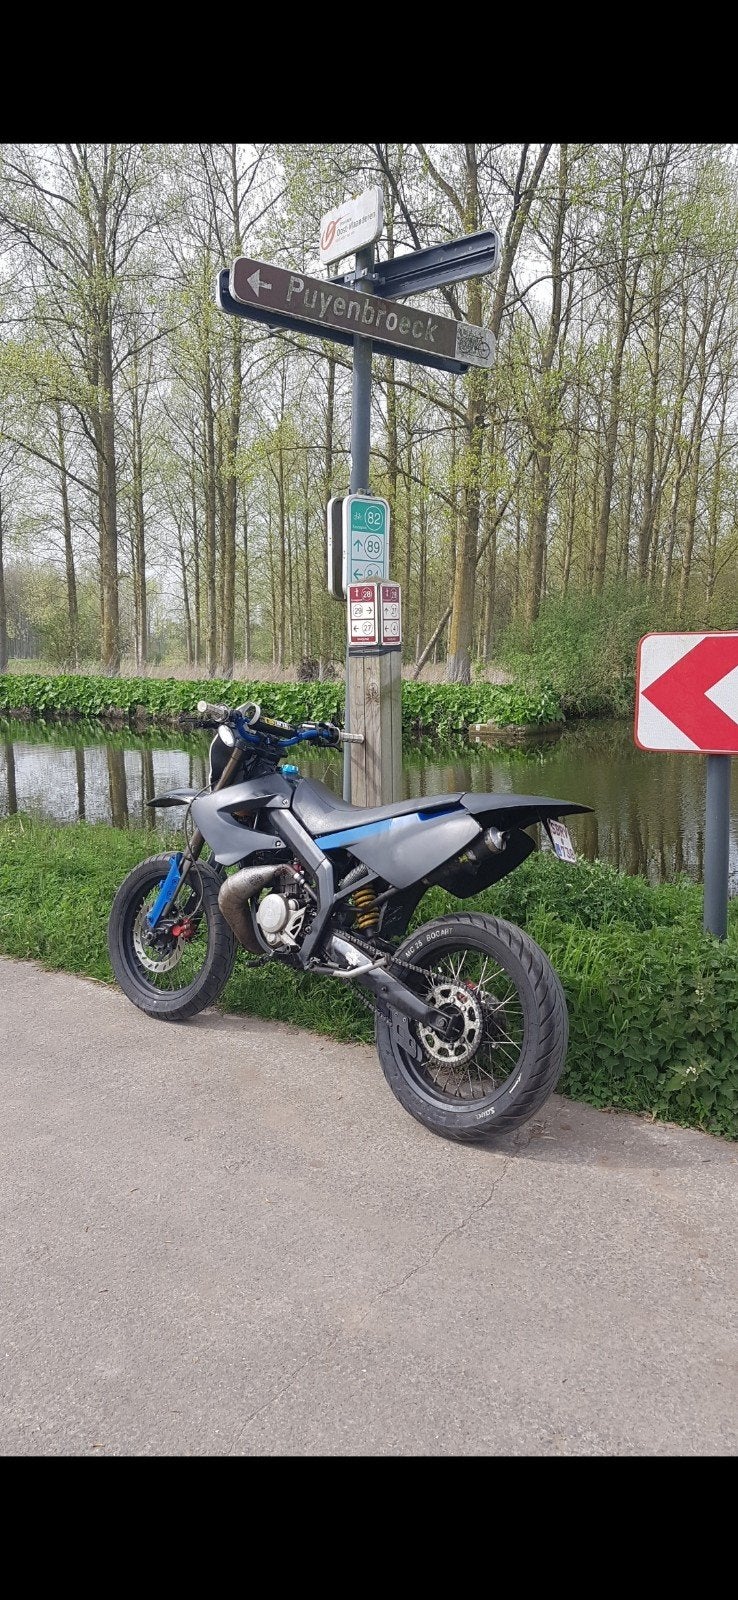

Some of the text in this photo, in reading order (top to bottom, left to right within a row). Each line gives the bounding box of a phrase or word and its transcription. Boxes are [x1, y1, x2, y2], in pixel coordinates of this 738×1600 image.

[286, 275, 439, 343] Puyenbroeck
[367, 511, 381, 525] 82
[367, 540, 380, 553] 89
